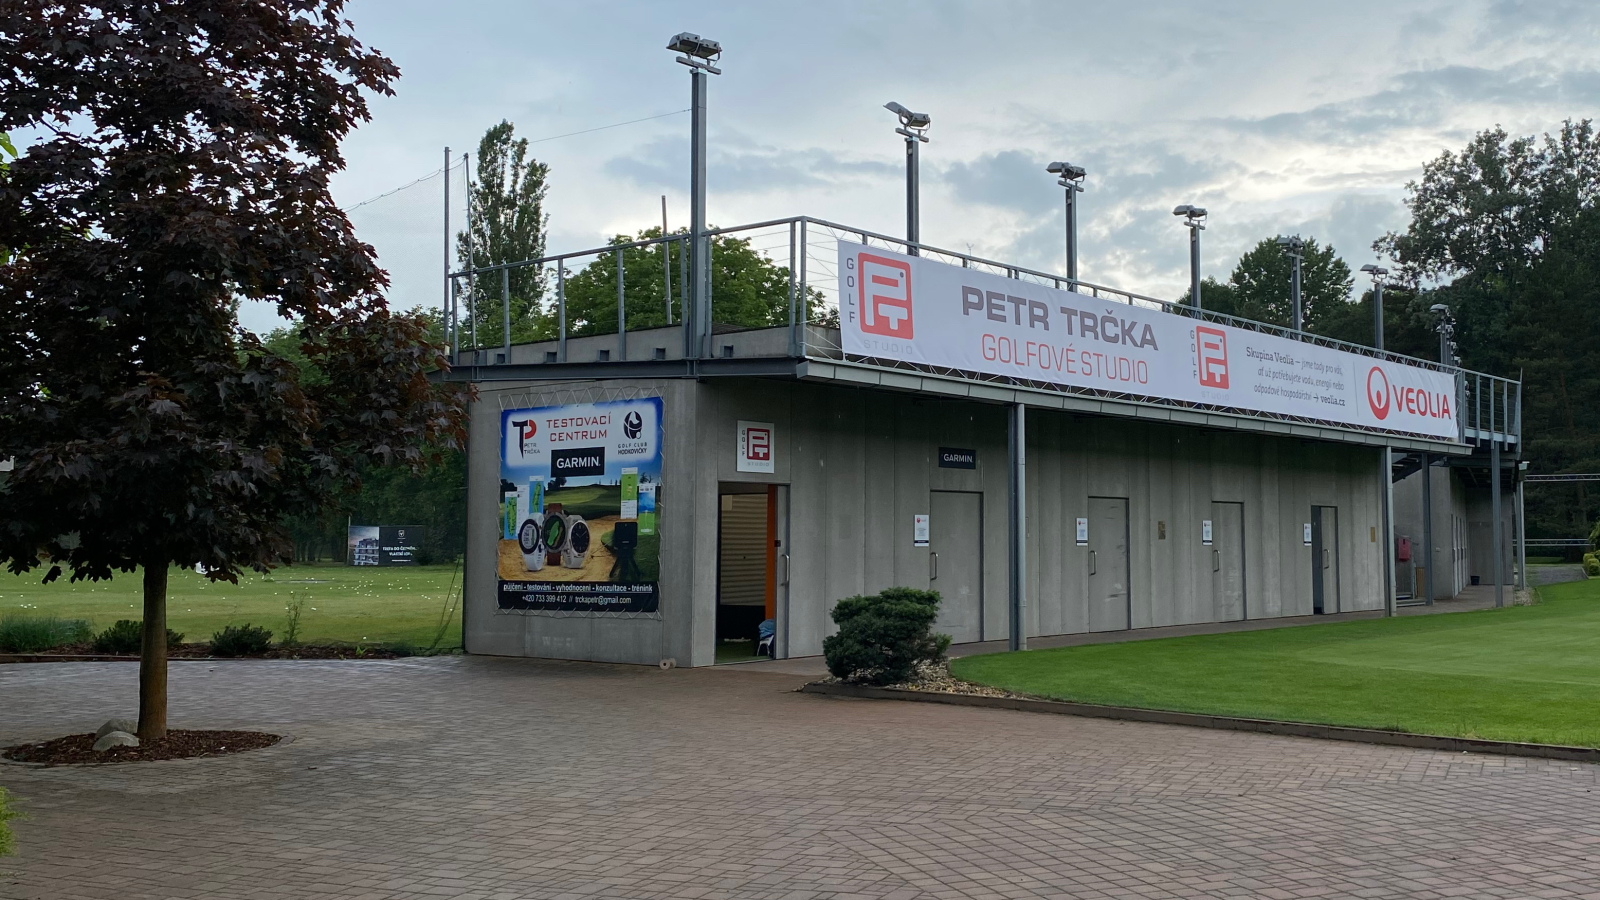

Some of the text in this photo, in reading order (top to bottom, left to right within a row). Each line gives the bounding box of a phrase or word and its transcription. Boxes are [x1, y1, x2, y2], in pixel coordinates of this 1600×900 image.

[846, 257, 855, 323] GOLF
[961, 285, 1159, 351] PETR TRČKA
[863, 339, 913, 355] STUDIO
[982, 333, 1149, 385] GOLFOVÉ STUDIO
[1246, 346, 1274, 362] Skupina
[1273, 351, 1295, 365] Veolia
[1301, 357, 1313, 370] jsme
[1325, 365, 1333, 374] pro
[1272, 369, 1301, 384] potřebujete
[1332, 381, 1345, 391] nebo
[1253, 383, 1280, 396] odpadové
[1320, 394, 1346, 407] veolia.cz
[1392, 384, 1452, 420] VEOLIA
[546, 411, 612, 429] TESTOVACÍ
[550, 429, 608, 442] CENTRUM
[617, 447, 648, 456] HODKOVIČKY
[943, 453, 973, 463] GARMIN
[556, 456, 600, 469] GARMIN
[503, 582, 524, 592] půjčení
[526, 583, 551, 591] testování
[555, 583, 591, 593] vyhodnocení
[595, 584, 627, 592] konzultace
[631, 583, 653, 592] trénink
[522, 594, 535, 602] +420
[556, 595, 567, 603] 412
[575, 595, 632, 605] trckapetr@gmail.com
